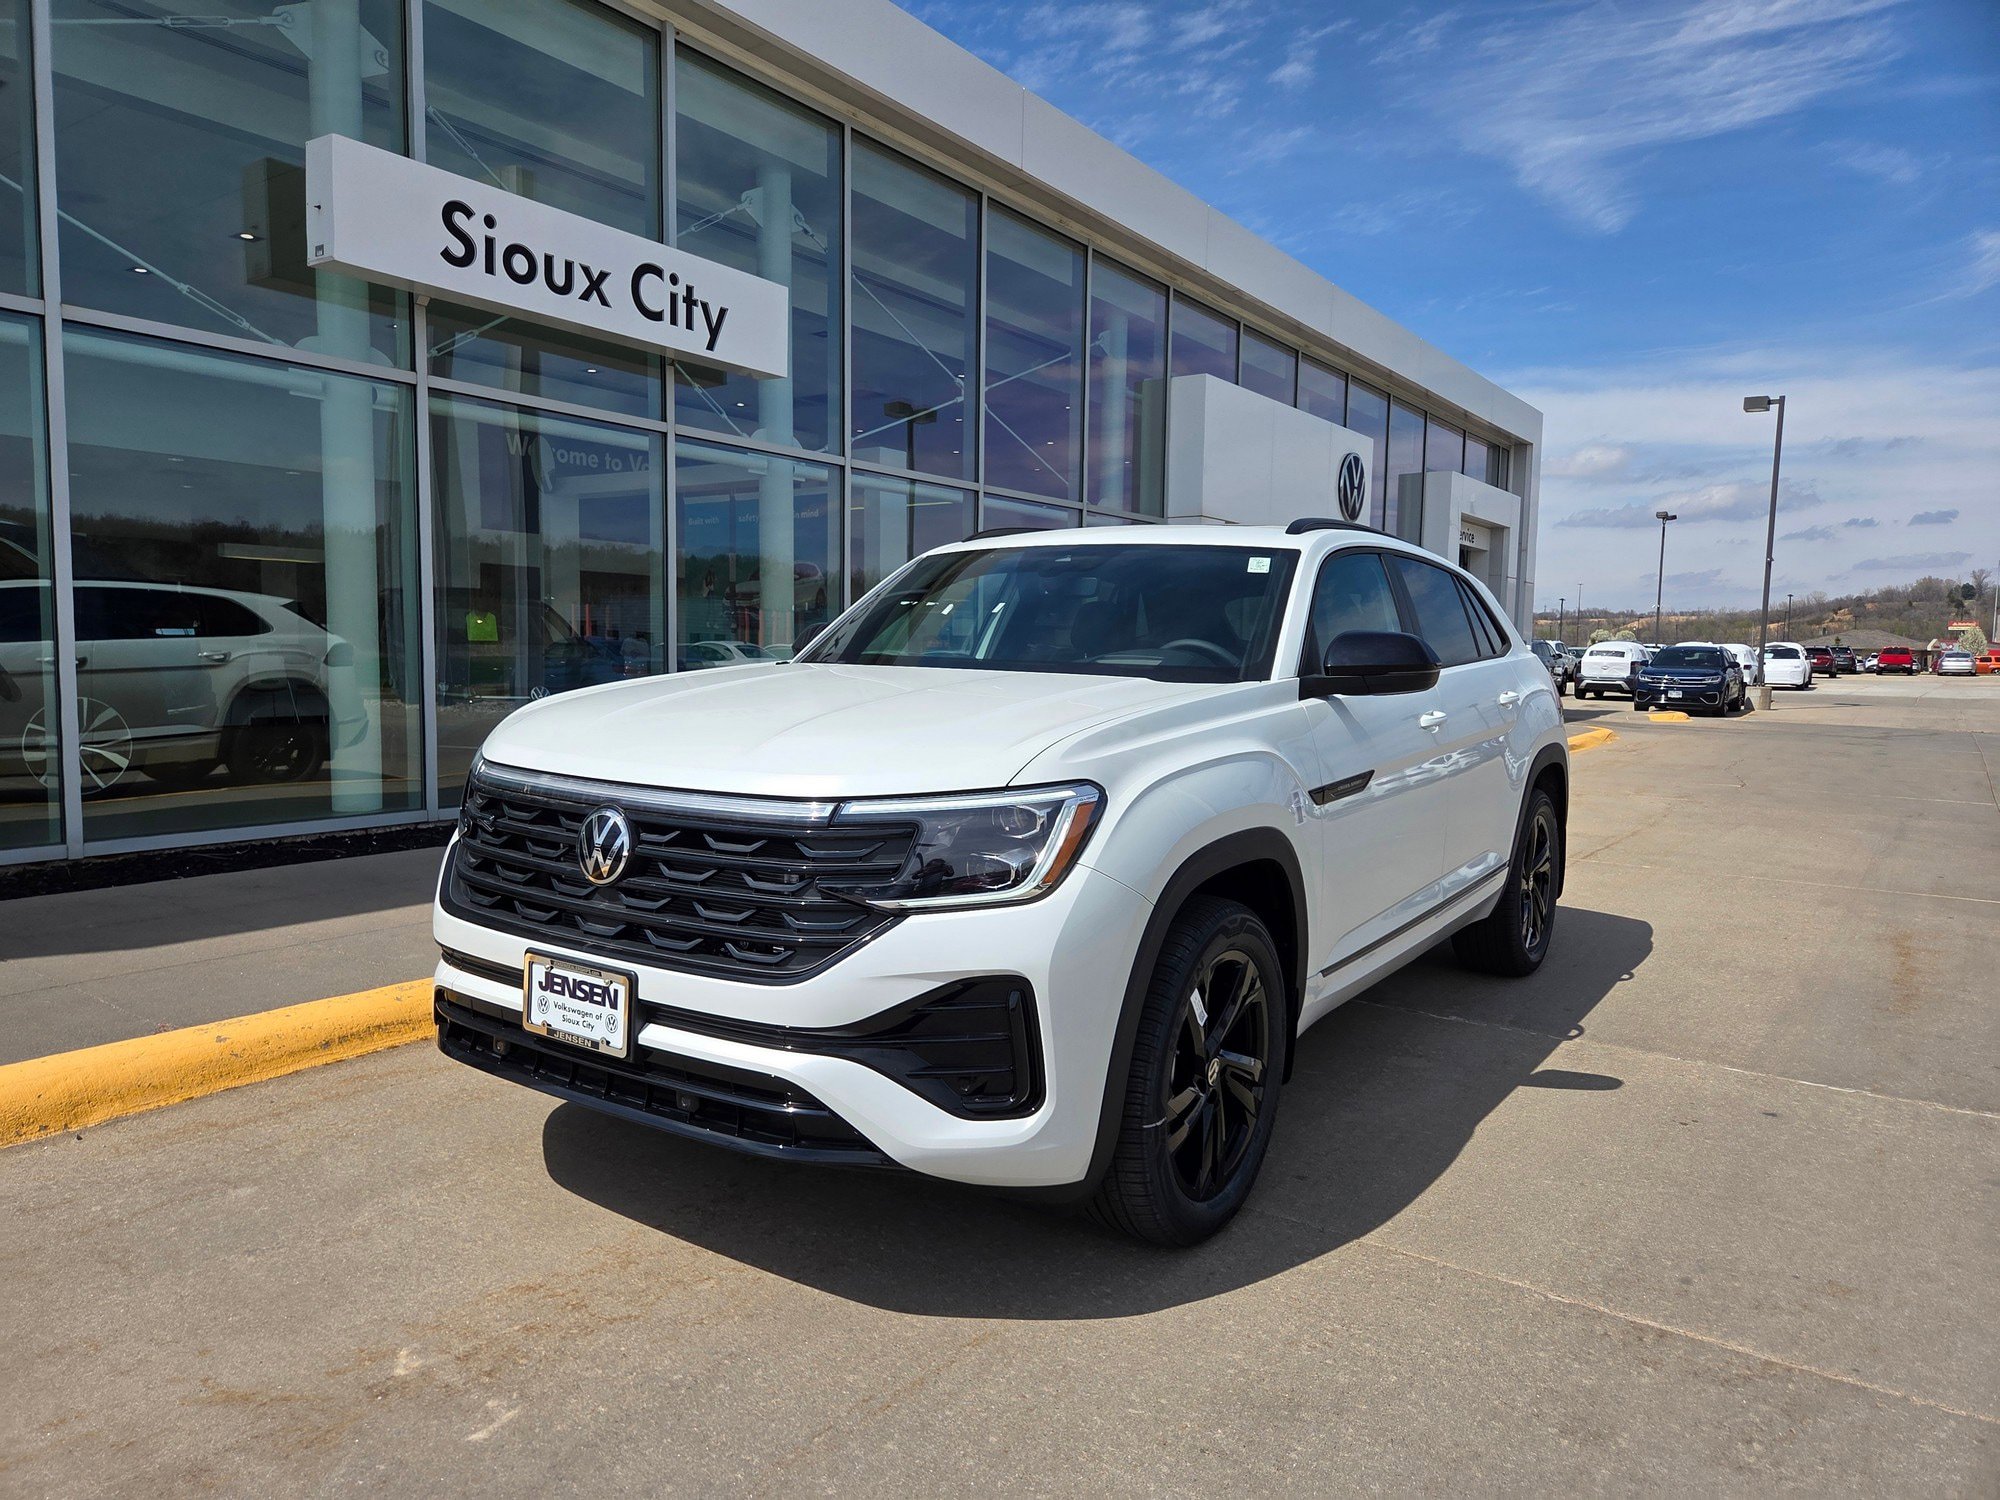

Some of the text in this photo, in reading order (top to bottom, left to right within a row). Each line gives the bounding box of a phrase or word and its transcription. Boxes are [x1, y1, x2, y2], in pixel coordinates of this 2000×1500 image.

[440, 200, 729, 351] Sioux City
[506, 432, 599, 468] Wome
[604, 452, 622, 471] to
[801, 509, 819, 518] mind
[1459, 528, 1475, 543] ervice
[538, 971, 618, 1010] JENSEN
[553, 1001, 603, 1021] Volkswagen of
[562, 1014, 595, 1031] Sioux City
[553, 1031, 592, 1048] JENSEN
